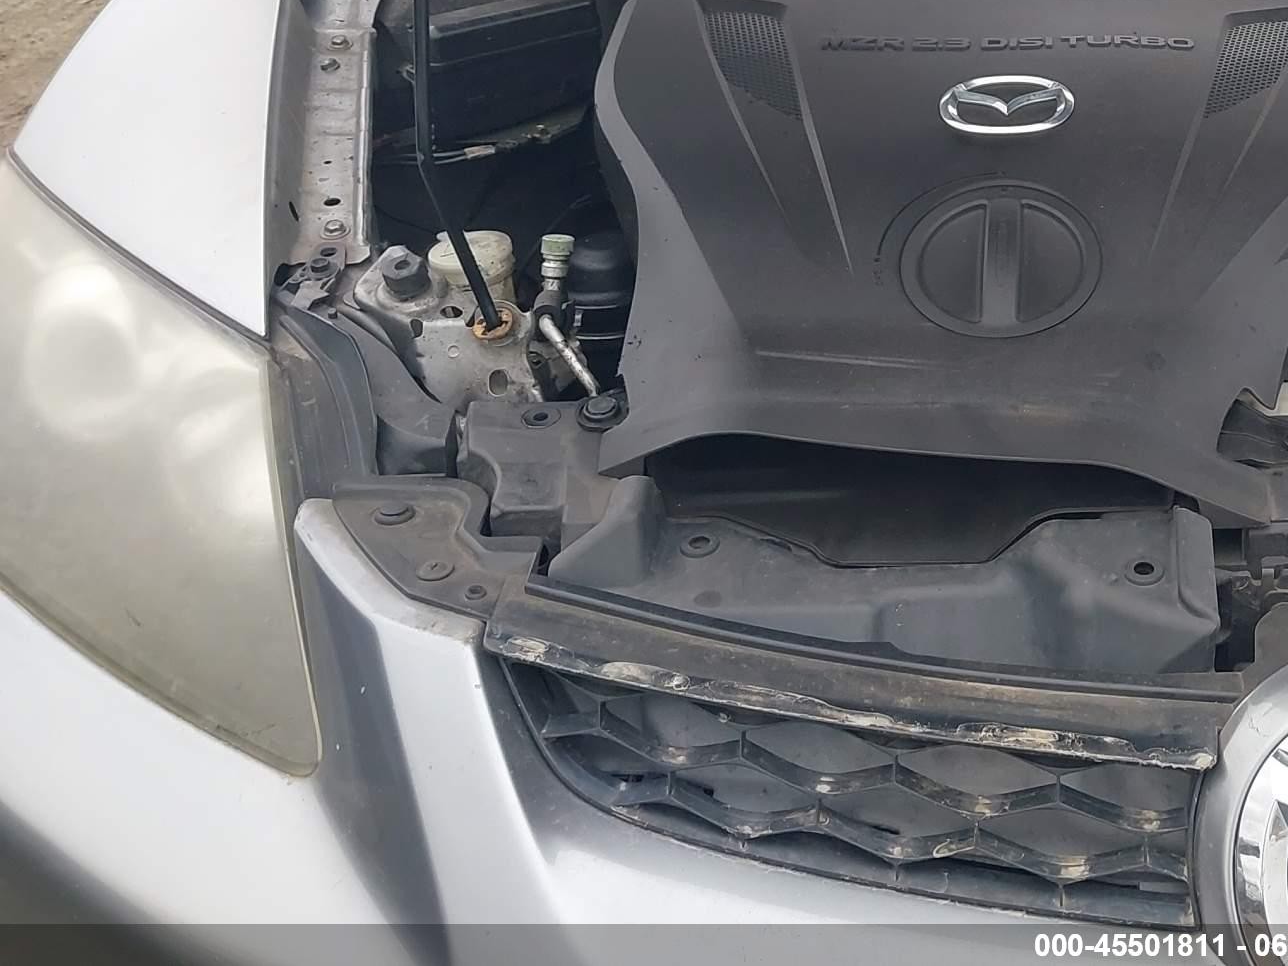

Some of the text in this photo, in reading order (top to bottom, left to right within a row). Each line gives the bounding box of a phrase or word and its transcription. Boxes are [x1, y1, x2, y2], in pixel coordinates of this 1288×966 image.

[821, 33, 1196, 52] MZR 2.3 DISI TURBO
